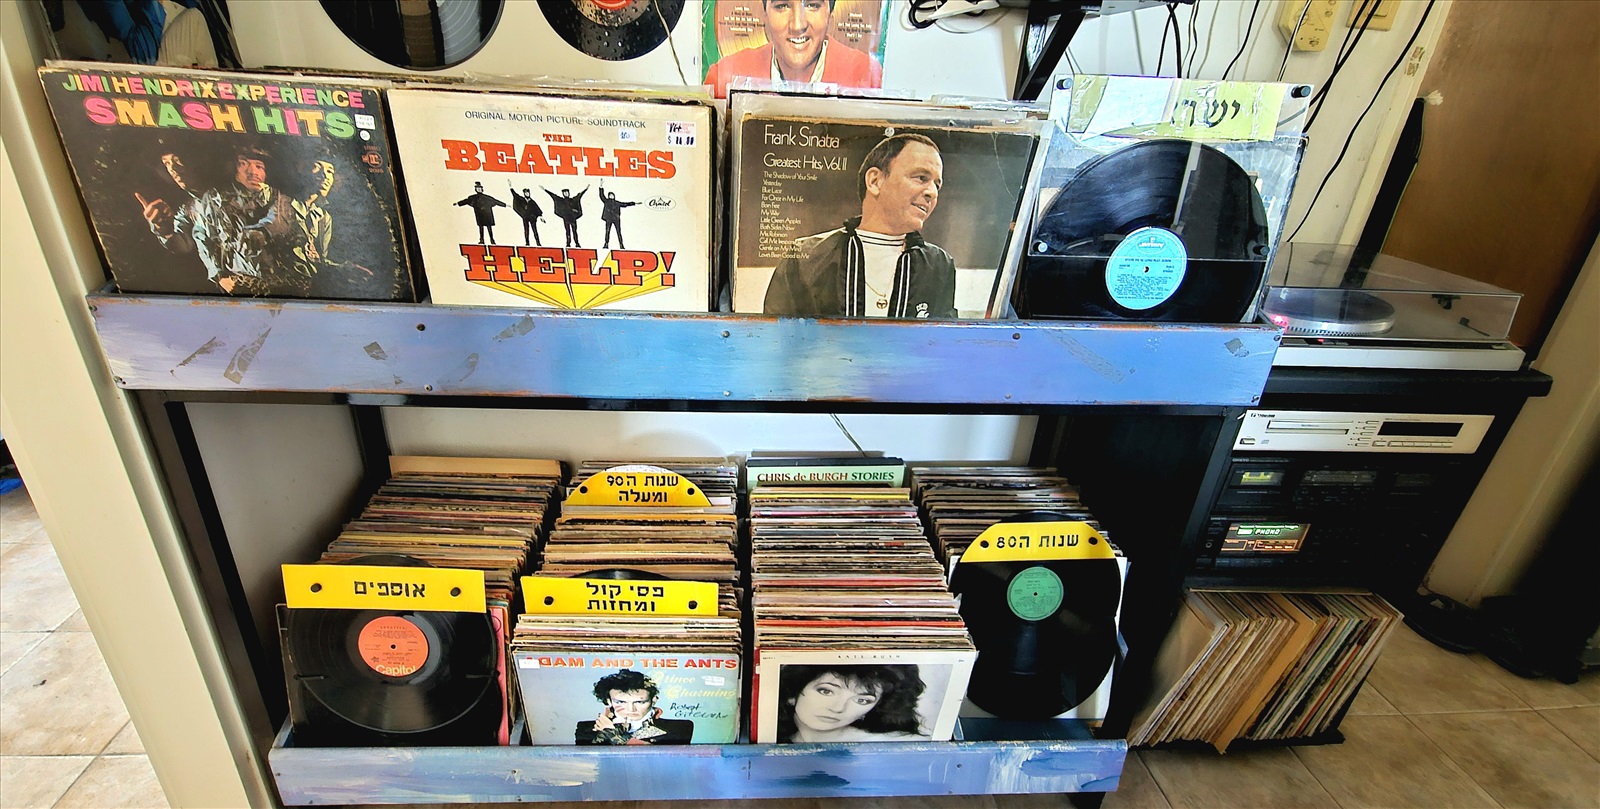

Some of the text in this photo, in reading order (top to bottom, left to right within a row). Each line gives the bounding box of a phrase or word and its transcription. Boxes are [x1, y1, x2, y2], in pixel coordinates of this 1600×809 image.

[62, 74, 365, 109] JIMI HENDRIX EXPERIENCE
[84, 96, 355, 139] SMASH HITS
[465, 110, 646, 129] ORIGINAL MOTION PICTURE SOUNDTRACK
[542, 133, 573, 143] THE
[764, 124, 840, 148] Frank Sinatra
[441, 138, 677, 179] BEATLES
[763, 152, 802, 169] Greatest
[459, 243, 676, 287] HELP!
[607, 475, 678, 487] שנות ה90
[757, 472, 894, 482] CHRIS de BURGH STORIES
[619, 489, 667, 502] ומעלה
[997, 534, 1078, 548] שנות ה80
[354, 581, 425, 598] אוספים
[586, 582, 664, 599] פסי קול
[587, 600, 655, 612] ומחזות
[526, 657, 737, 669] DAM AND THE ANTS
